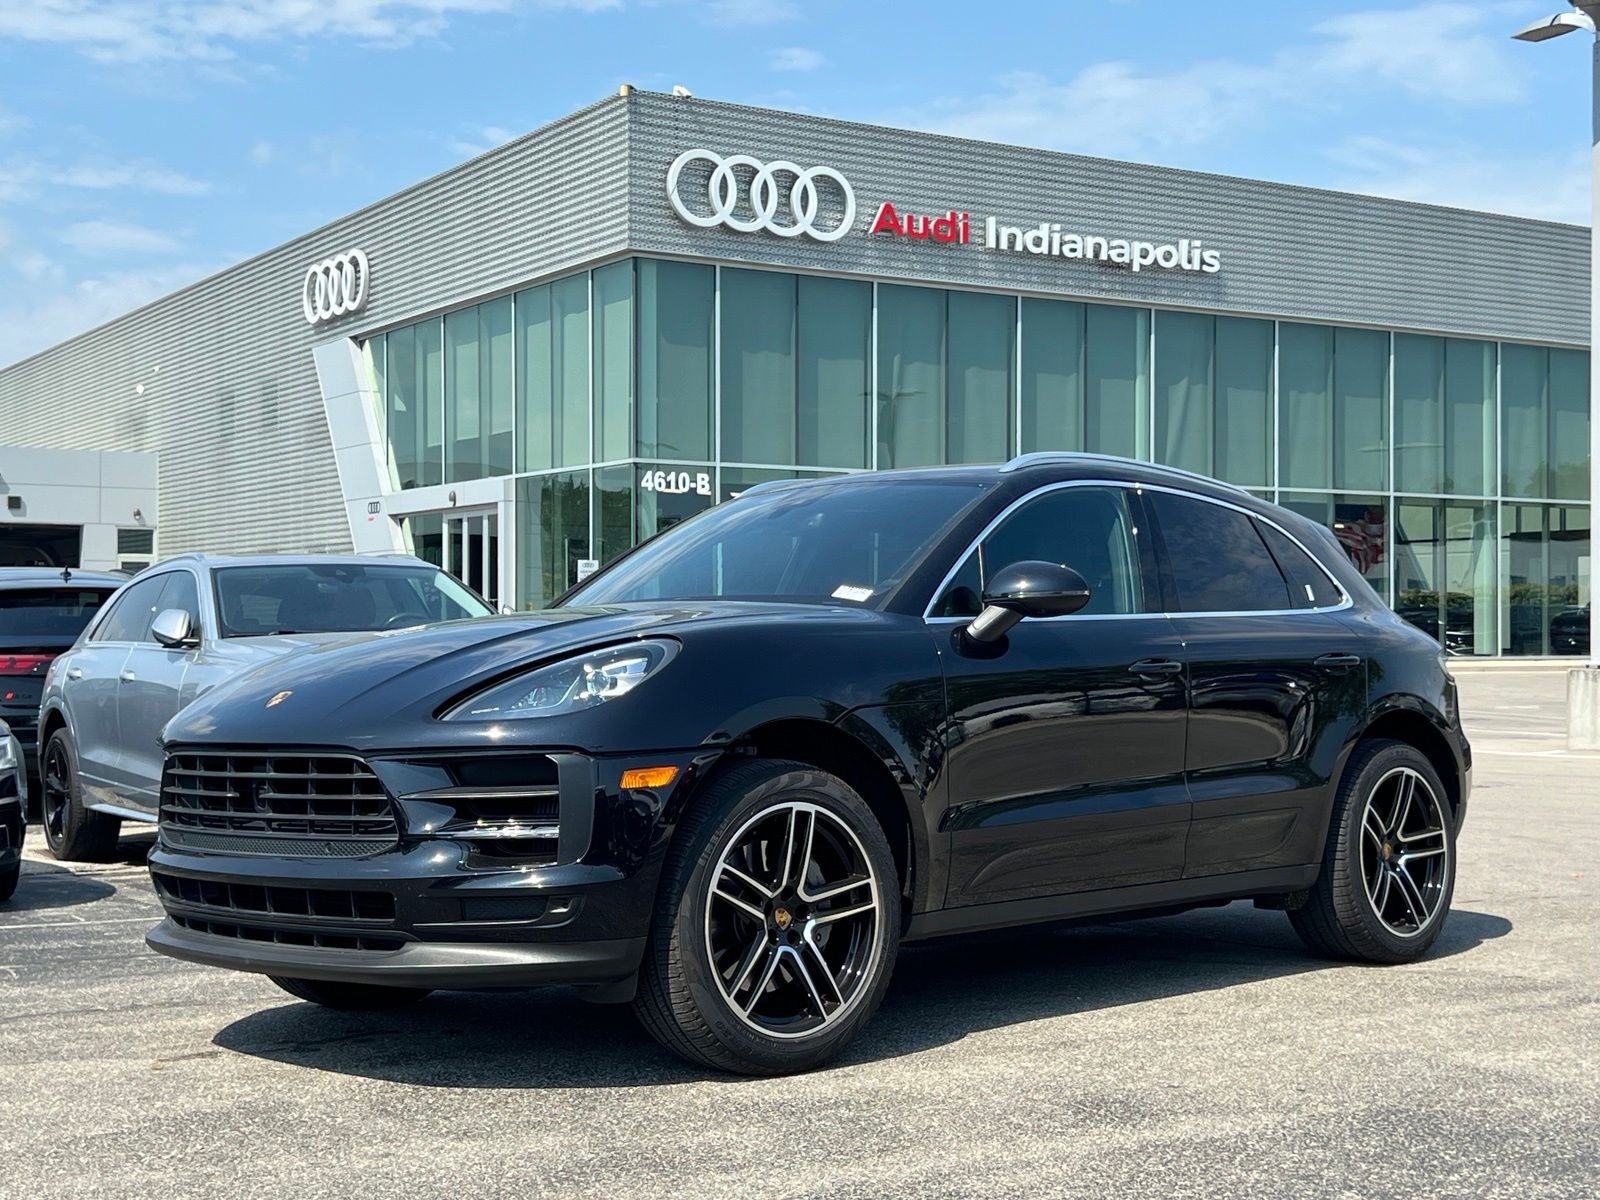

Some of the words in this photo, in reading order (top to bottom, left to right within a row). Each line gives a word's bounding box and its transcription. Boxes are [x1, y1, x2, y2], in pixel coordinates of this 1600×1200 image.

[868, 201, 970, 245] Audi
[985, 216, 1221, 273] Indianapolis
[641, 470, 711, 495] 4610-B
